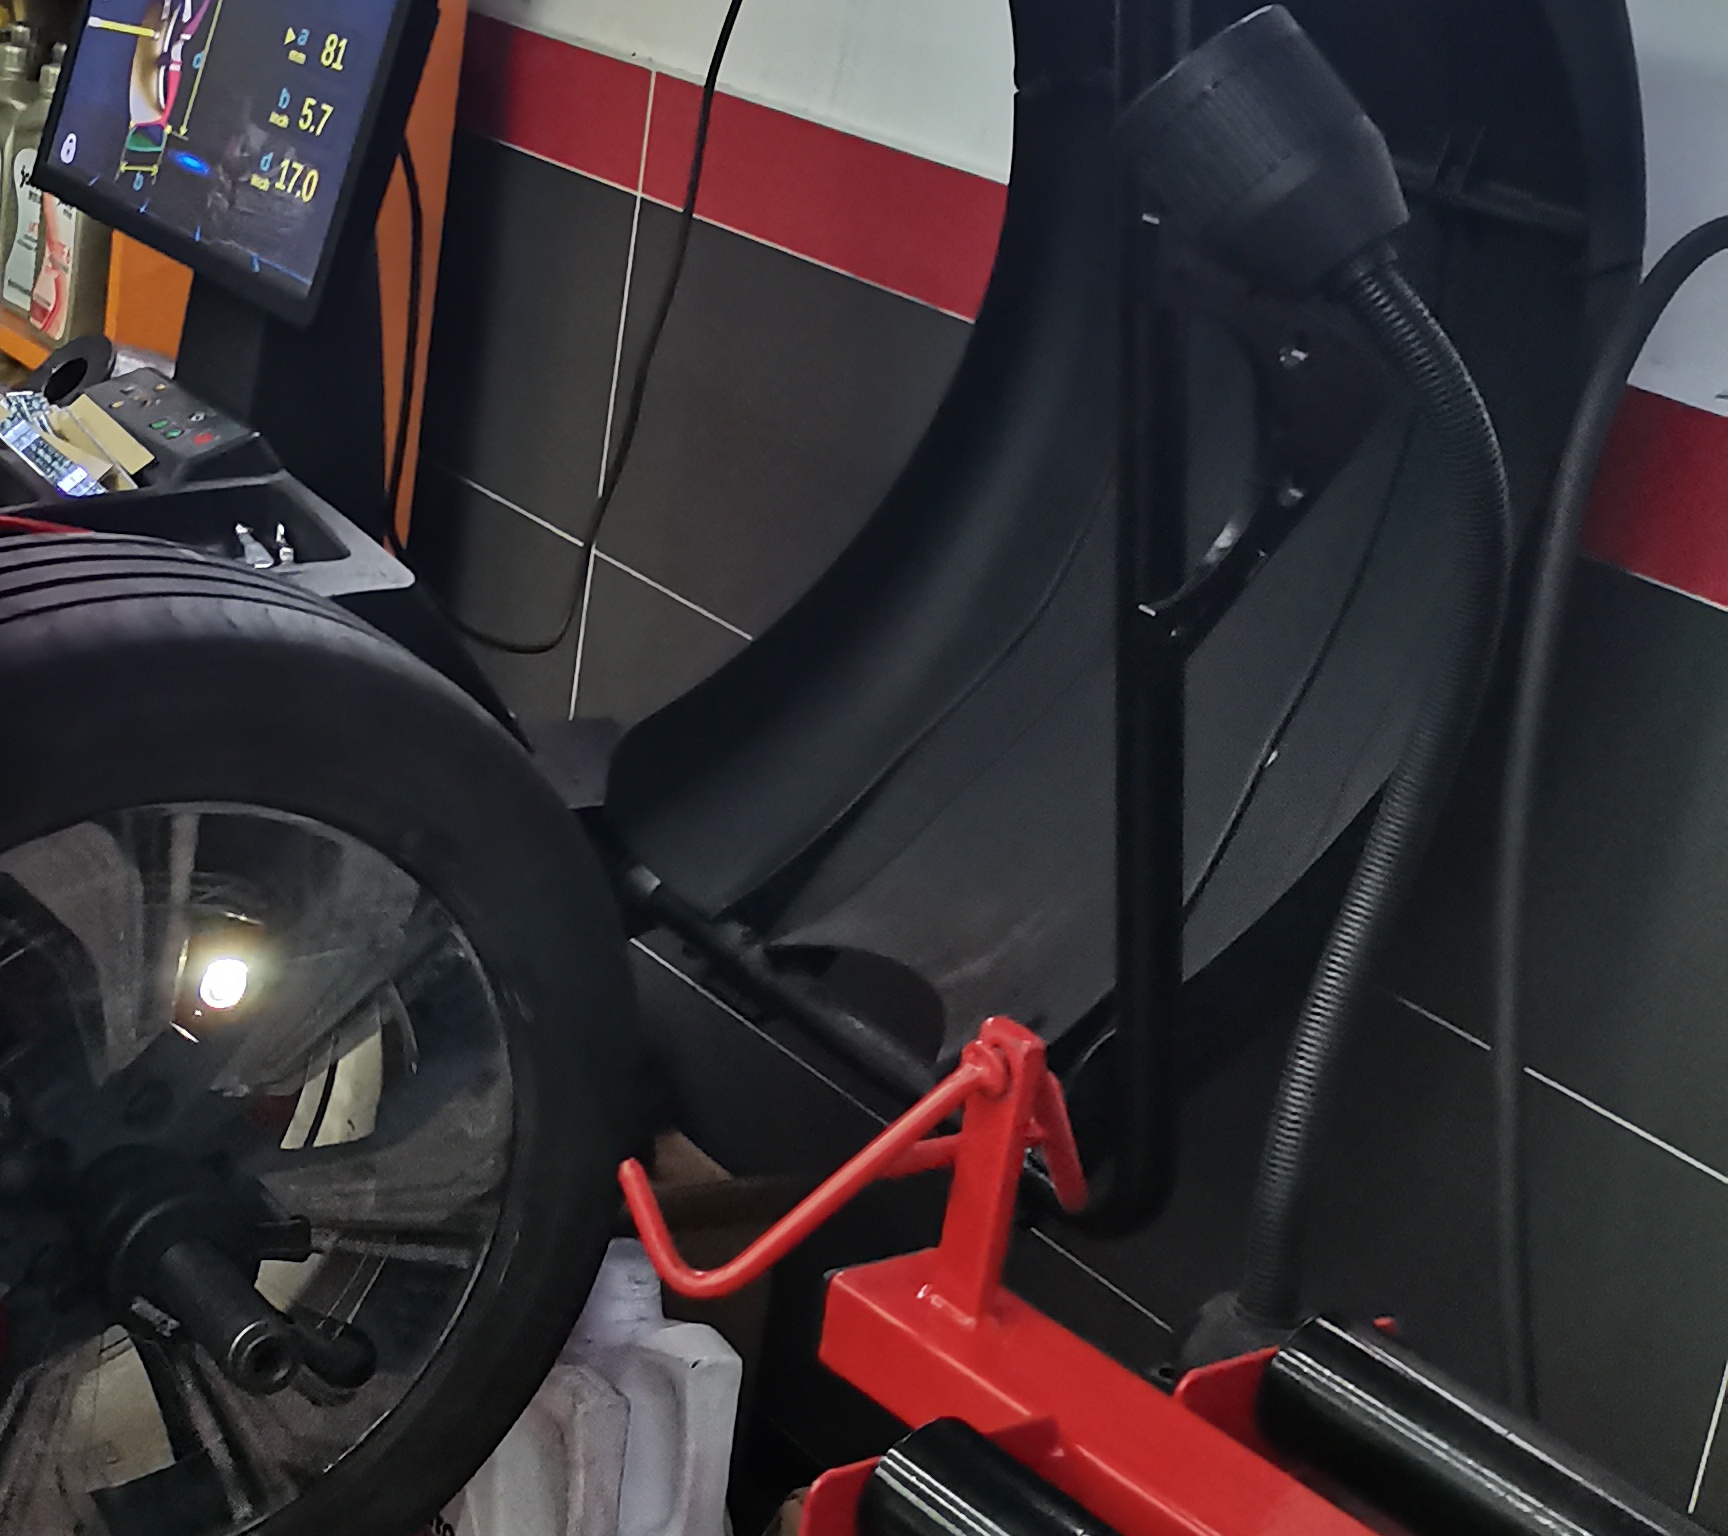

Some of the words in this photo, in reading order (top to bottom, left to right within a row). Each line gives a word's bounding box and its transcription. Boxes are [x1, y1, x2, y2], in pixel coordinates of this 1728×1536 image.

[321, 33, 348, 71] 81
[278, 87, 290, 109] b
[298, 97, 334, 136] 5.7
[260, 151, 274, 172] d
[275, 158, 319, 203] 17.0
